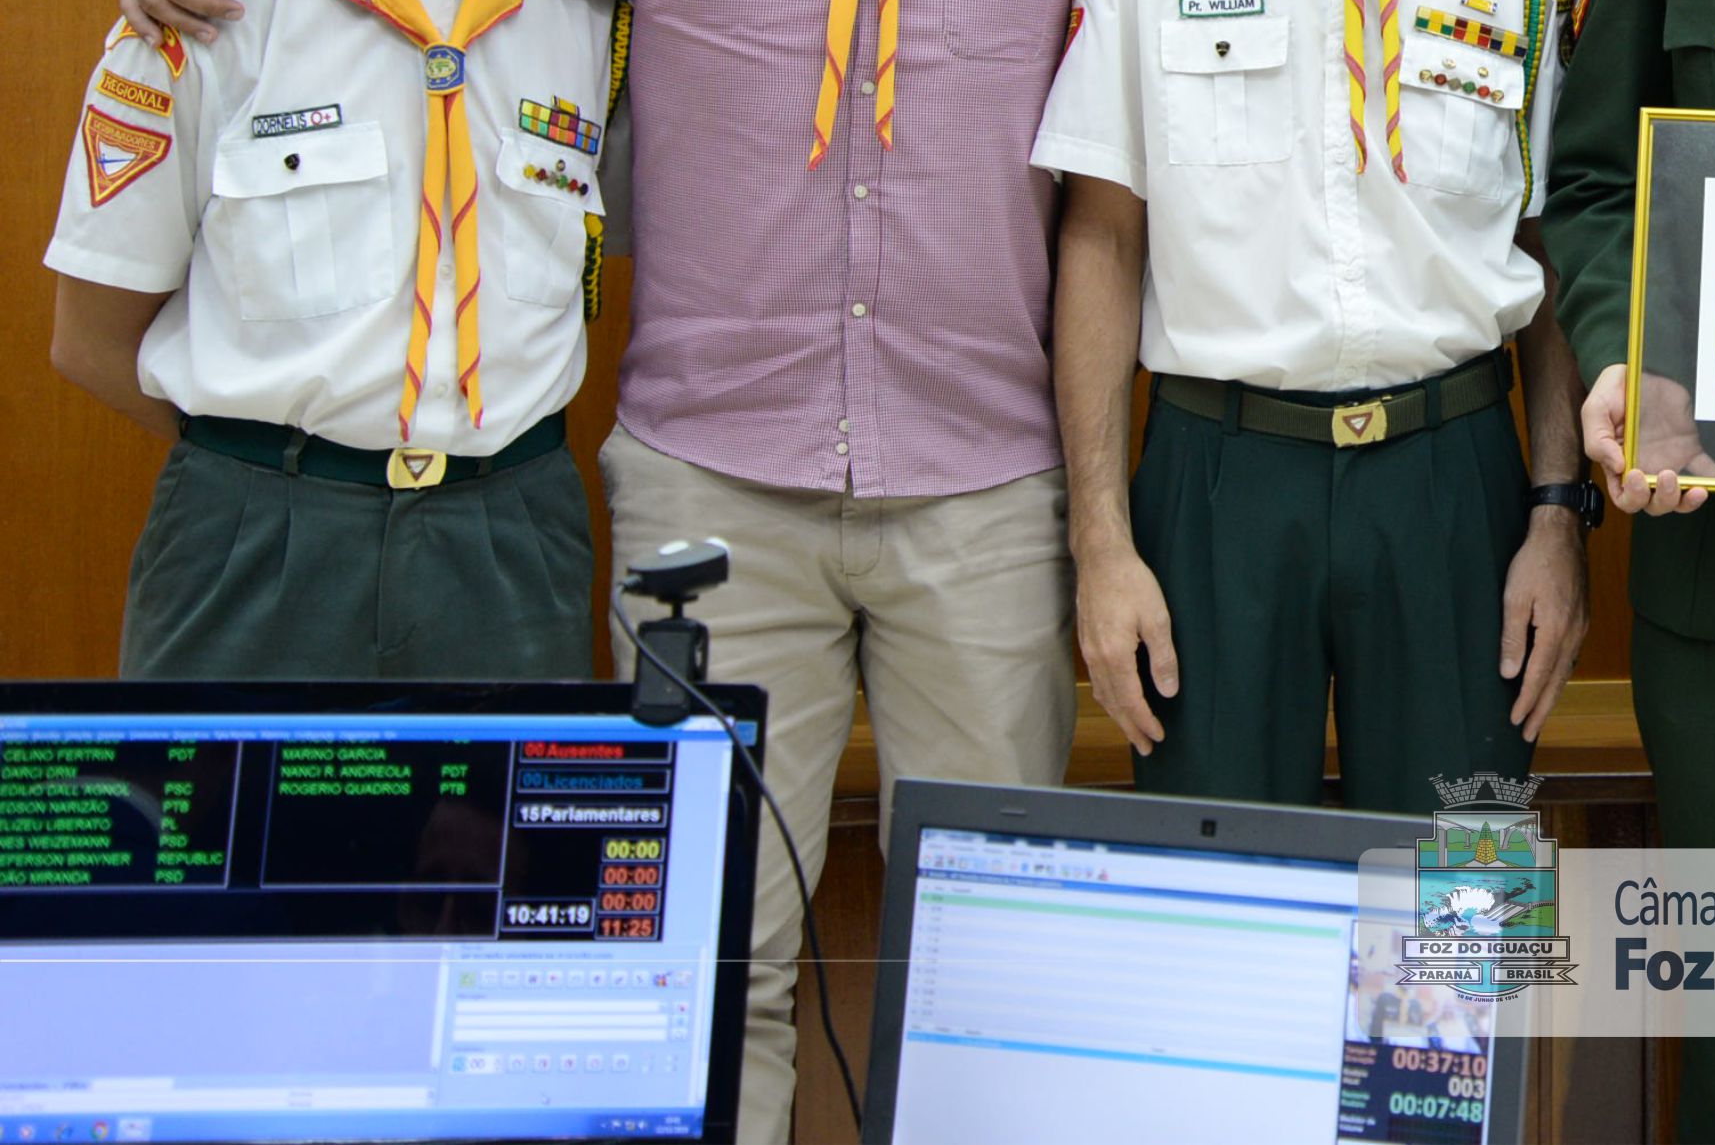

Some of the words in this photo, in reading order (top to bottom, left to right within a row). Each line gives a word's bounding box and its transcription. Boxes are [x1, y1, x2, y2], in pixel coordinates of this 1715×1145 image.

[103, 76, 165, 110] REGIONAL
[168, 748, 196, 761] PDT
[337, 748, 387, 761] GARCIA
[340, 765, 412, 778] ANDREOLA
[441, 765, 468, 778] PDT
[439, 782, 466, 795] PTB
[544, 774, 644, 791] Licenciados
[162, 800, 191, 813] PTB
[159, 835, 189, 848] PSD
[606, 840, 660, 859] 00:00
[157, 852, 225, 865] REPUBLIC
[155, 869, 185, 883] PSD
[604, 867, 658, 885] 00:00
[602, 892, 656, 910] 00:00
[507, 905, 590, 925] 10:41:19
[601, 918, 652, 937] 11:25
[1392, 1048, 1488, 1077] 00:37:10
[1448, 1076, 1486, 1099] 003
[1389, 1092, 1484, 1123] 00:07:48
